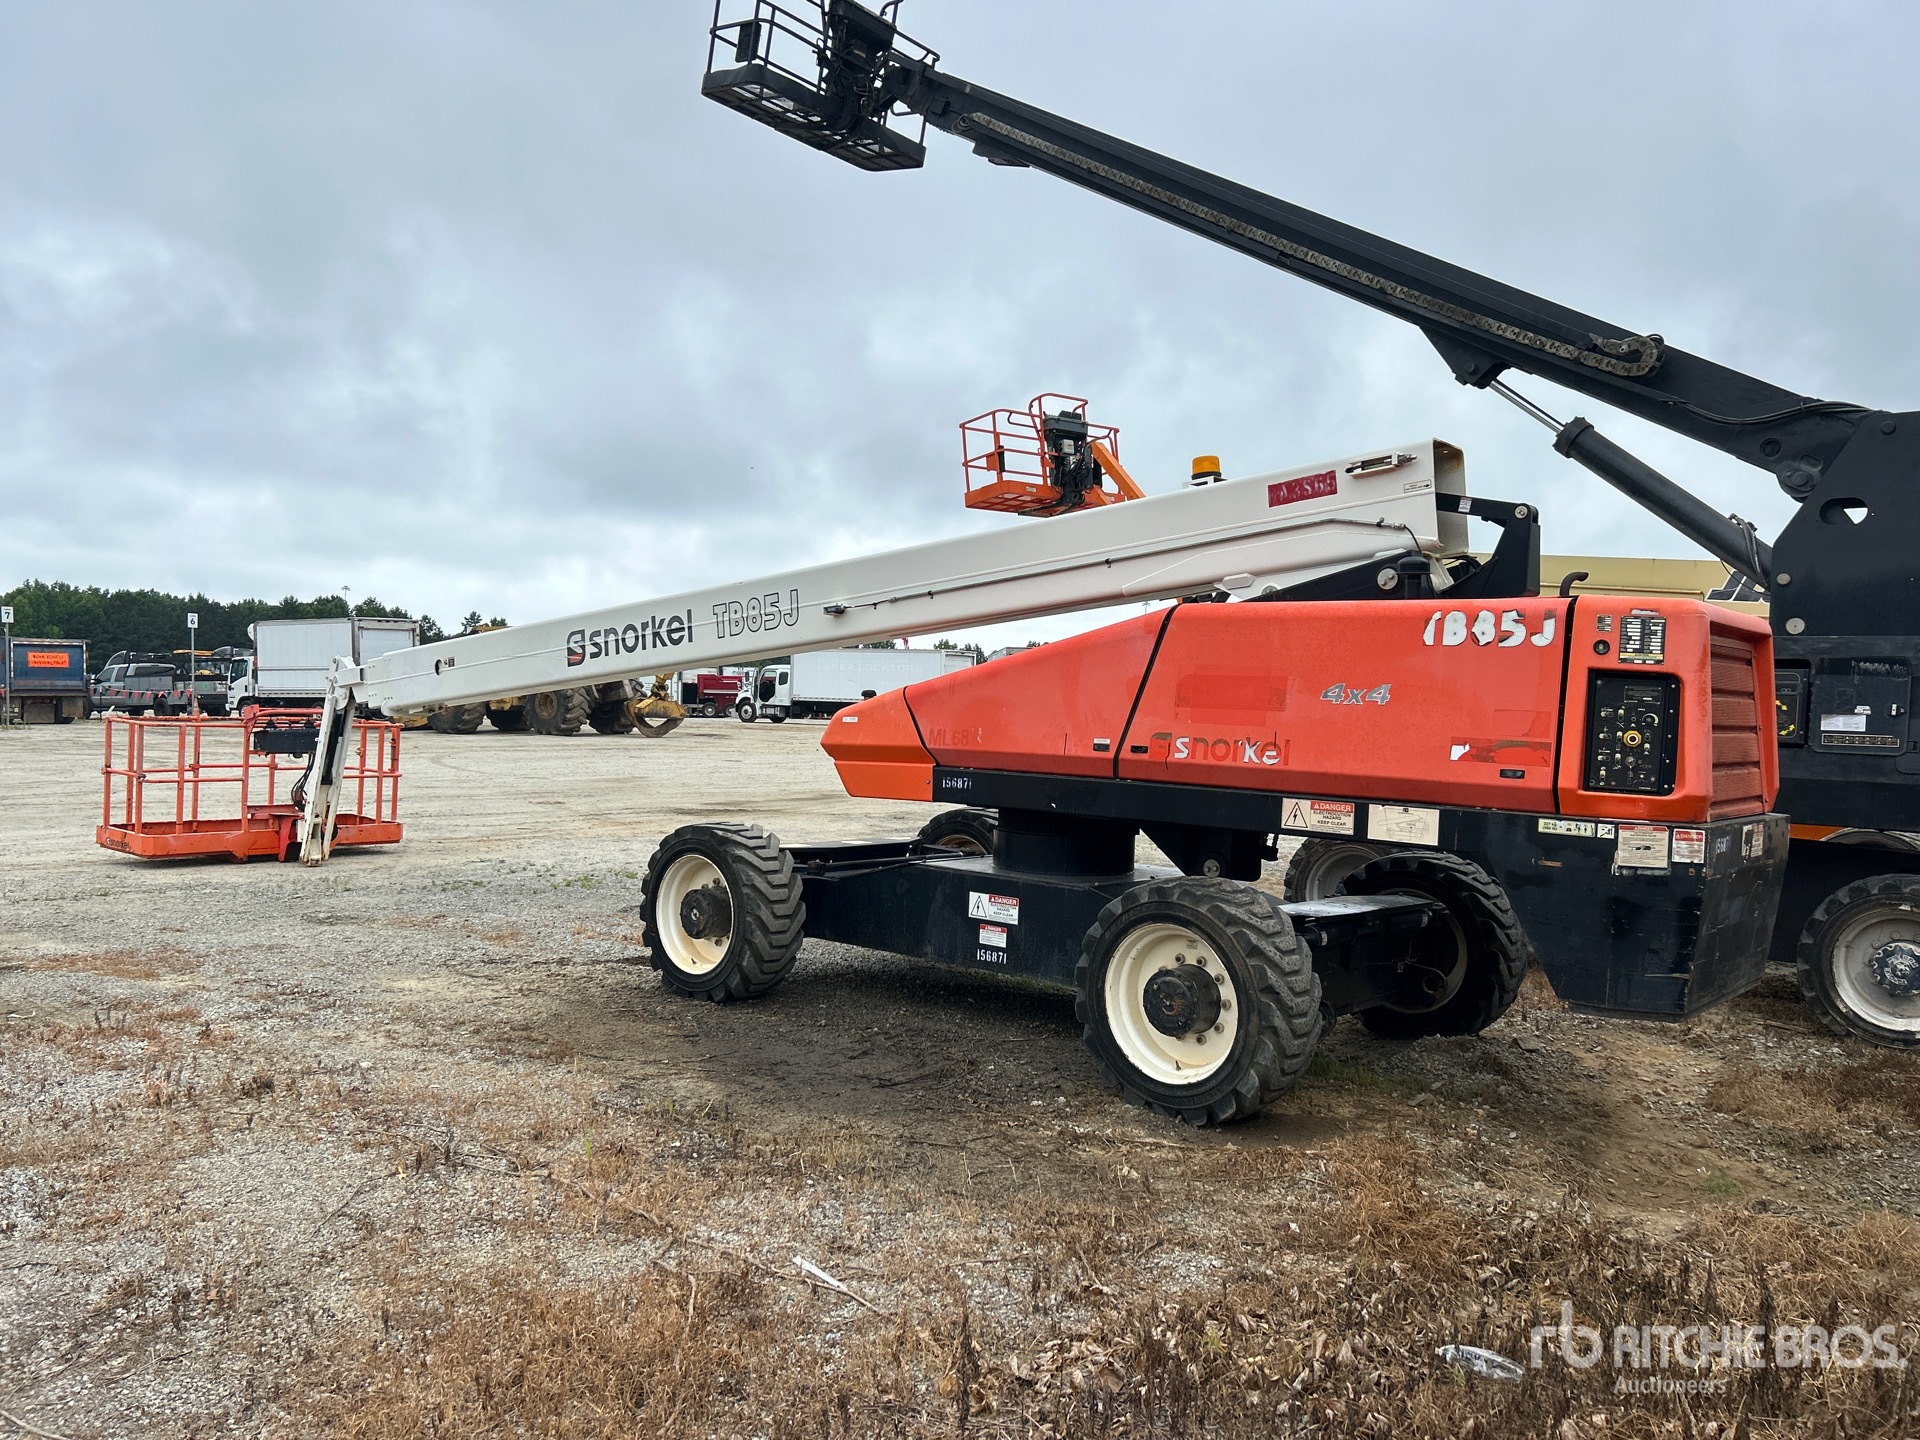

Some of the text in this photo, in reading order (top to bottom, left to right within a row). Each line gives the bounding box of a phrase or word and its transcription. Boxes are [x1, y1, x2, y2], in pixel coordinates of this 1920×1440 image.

[4, 612, 10, 620] 7
[589, 609, 694, 659] snorkel
[712, 588, 799, 639] TB85J
[1320, 683, 1392, 706] 4x4
[1320, 803, 1351, 812] DANGER
[995, 897, 1017, 906] DANGER
[977, 948, 1007, 964] 156871
